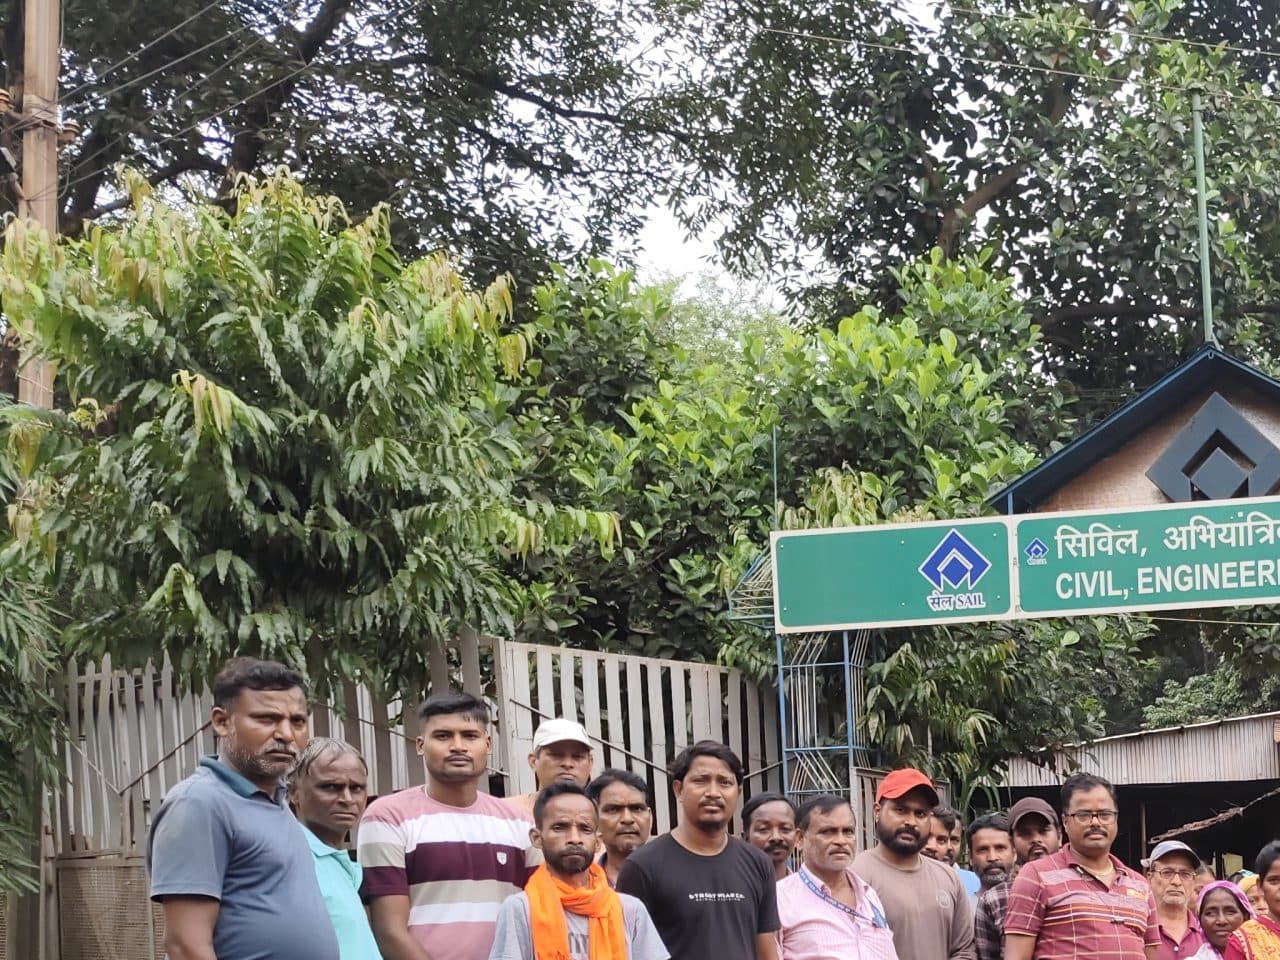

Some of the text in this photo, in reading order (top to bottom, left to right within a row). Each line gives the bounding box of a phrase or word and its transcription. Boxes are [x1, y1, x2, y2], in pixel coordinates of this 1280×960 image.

[1054, 522, 1147, 559] सिविल,
[1055, 570, 1129, 600] CIVIL,
[956, 593, 985, 608] SAIL
